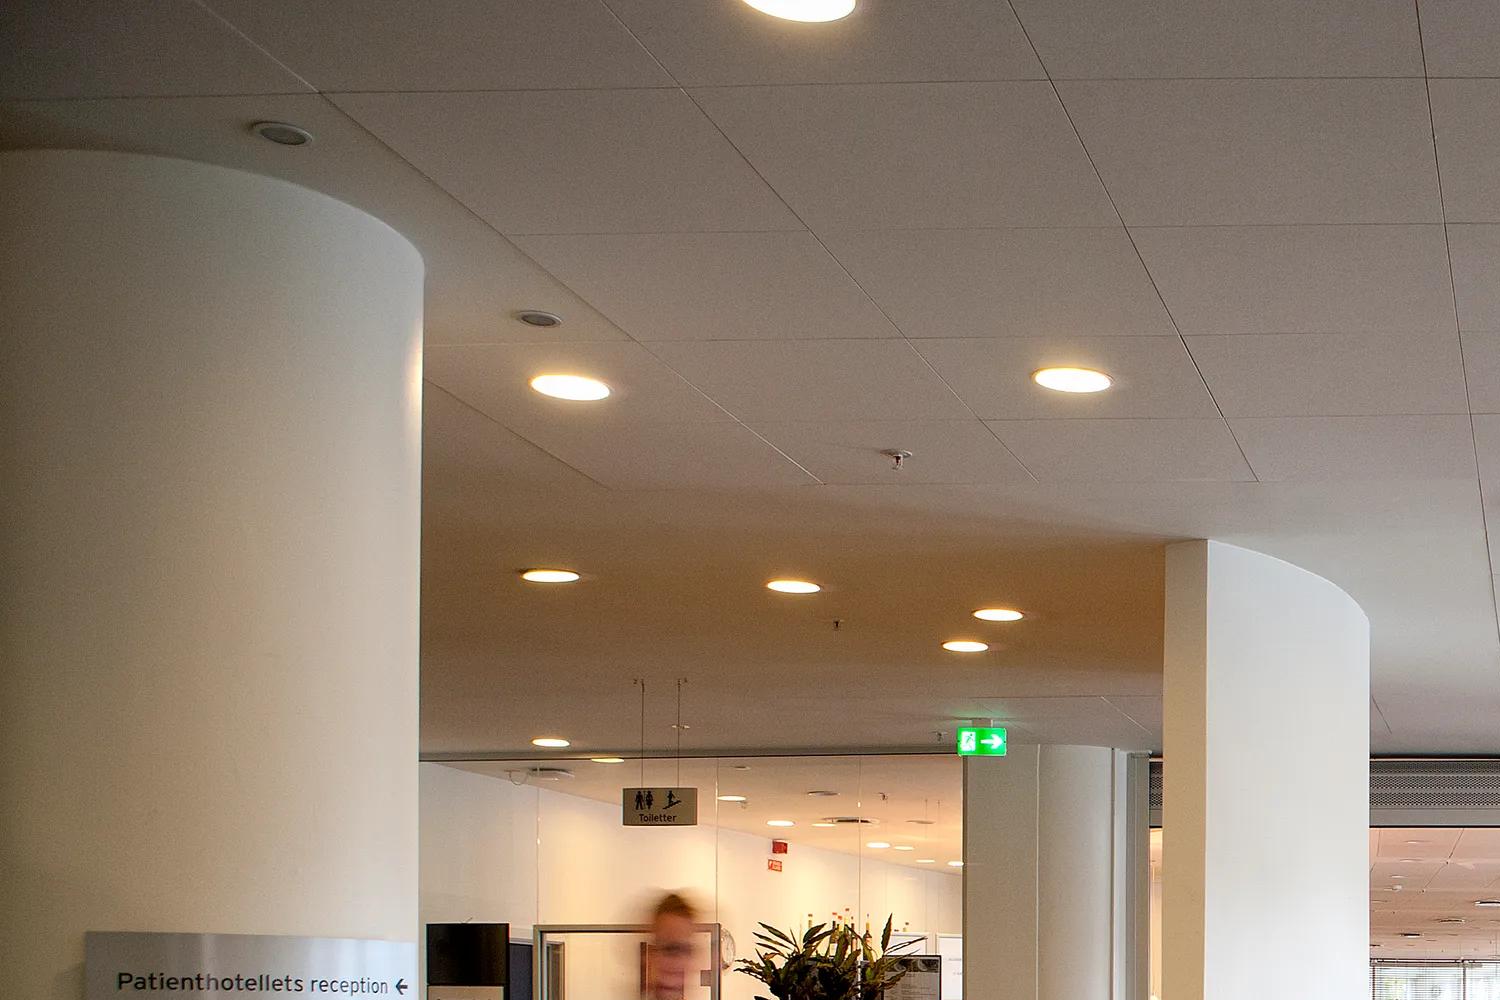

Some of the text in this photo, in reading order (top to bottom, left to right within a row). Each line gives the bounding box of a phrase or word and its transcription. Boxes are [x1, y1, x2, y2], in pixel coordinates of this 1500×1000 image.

[639, 813, 677, 822] Toiletter
[117, 972, 389, 996] Patienthotellets reception
